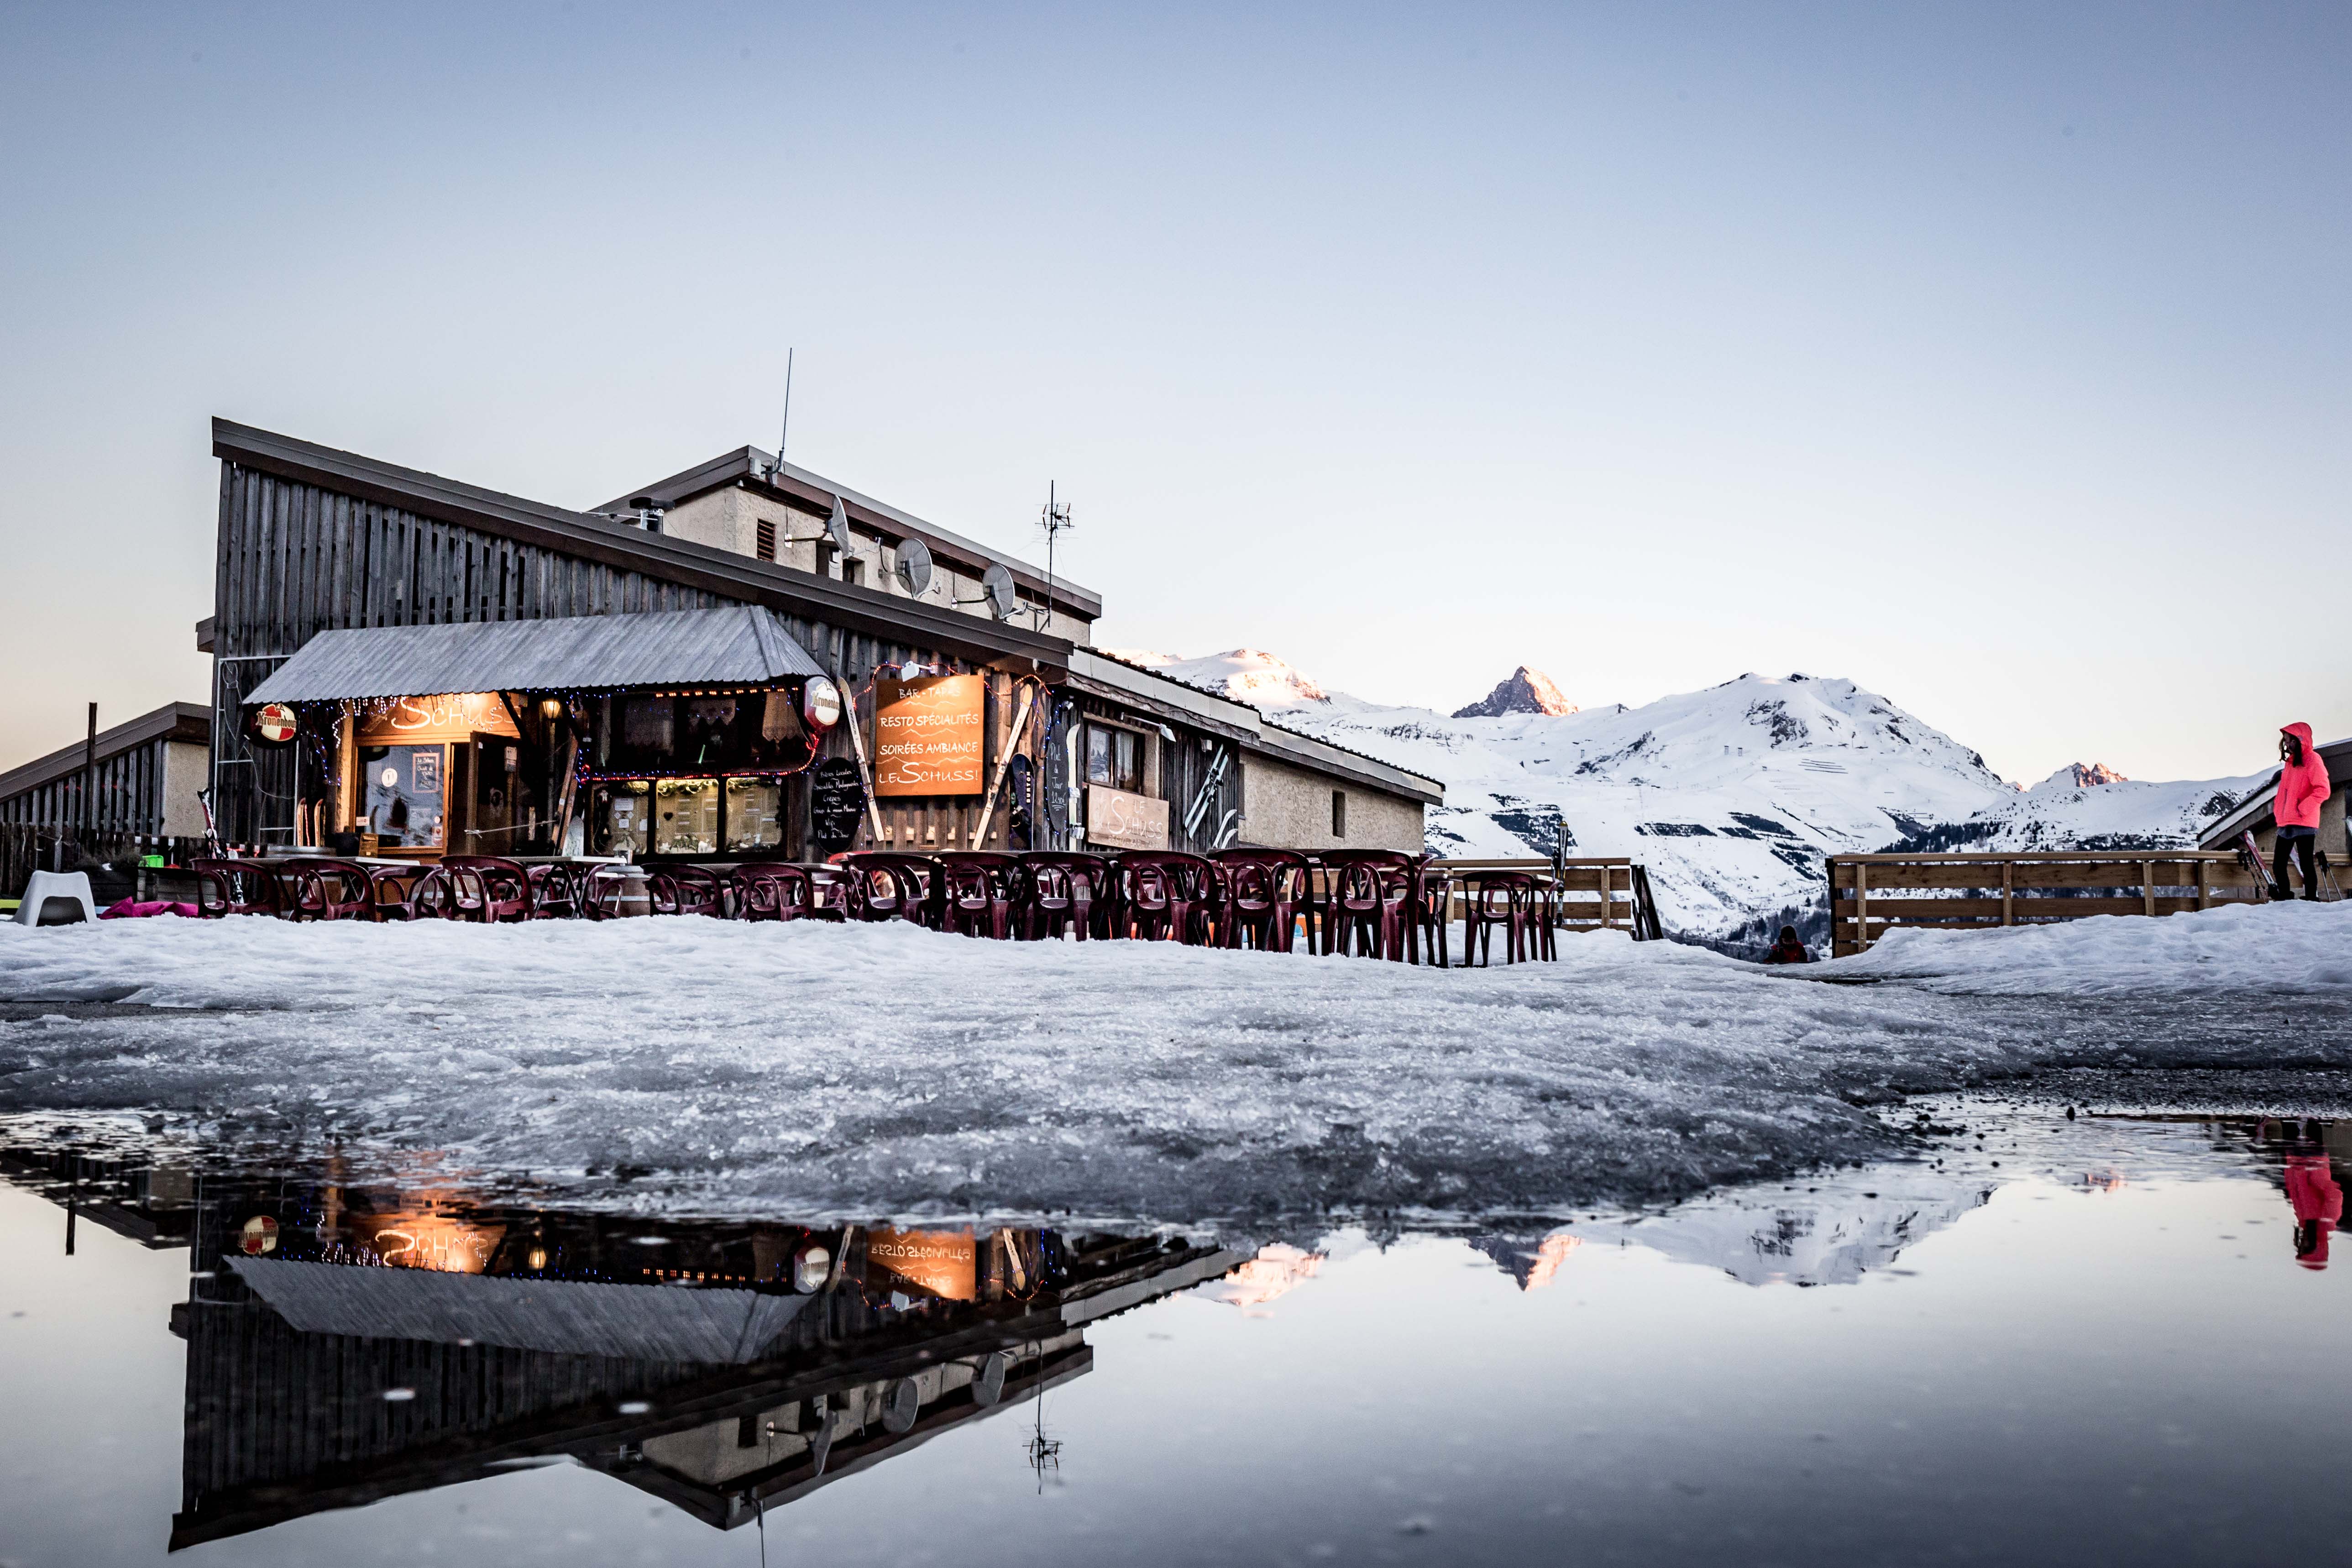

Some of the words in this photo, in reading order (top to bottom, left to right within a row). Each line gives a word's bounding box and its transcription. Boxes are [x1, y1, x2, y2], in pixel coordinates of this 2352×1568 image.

[898, 688, 921, 699] BAR
[880, 716, 914, 727] RESTO
[915, 711, 979, 726] SPÉCIALITÉS
[880, 741, 923, 755] SOIRÉES
[925, 742, 978, 754] AMBIANCE
[879, 772, 897, 783] LE
[897, 762, 978, 784] SCHUSS!
[1134, 800, 1146, 815] LE
[1107, 796, 1163, 839] SCHUSS
